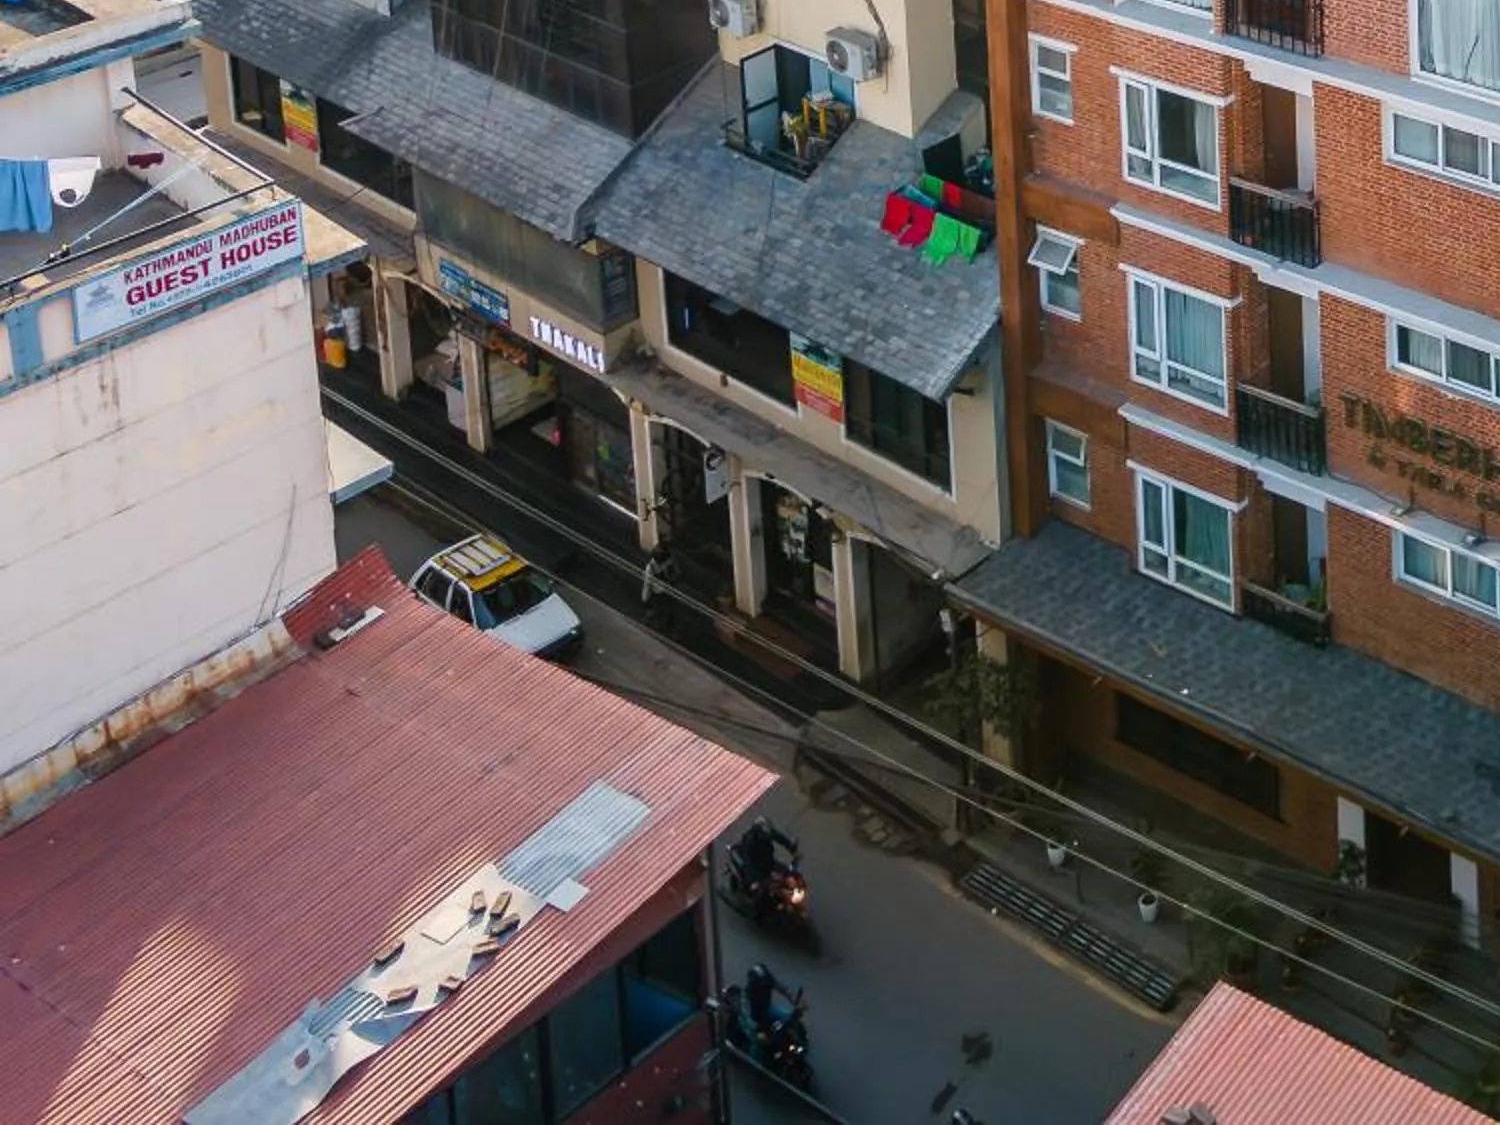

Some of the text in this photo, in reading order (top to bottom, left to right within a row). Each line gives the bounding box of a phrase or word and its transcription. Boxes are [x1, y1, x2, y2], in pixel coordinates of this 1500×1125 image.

[123, 206, 297, 284] KATHMANDU MADHUBAN
[126, 225, 297, 305] GUEST HOUSE
[529, 316, 605, 373] THAKALI
